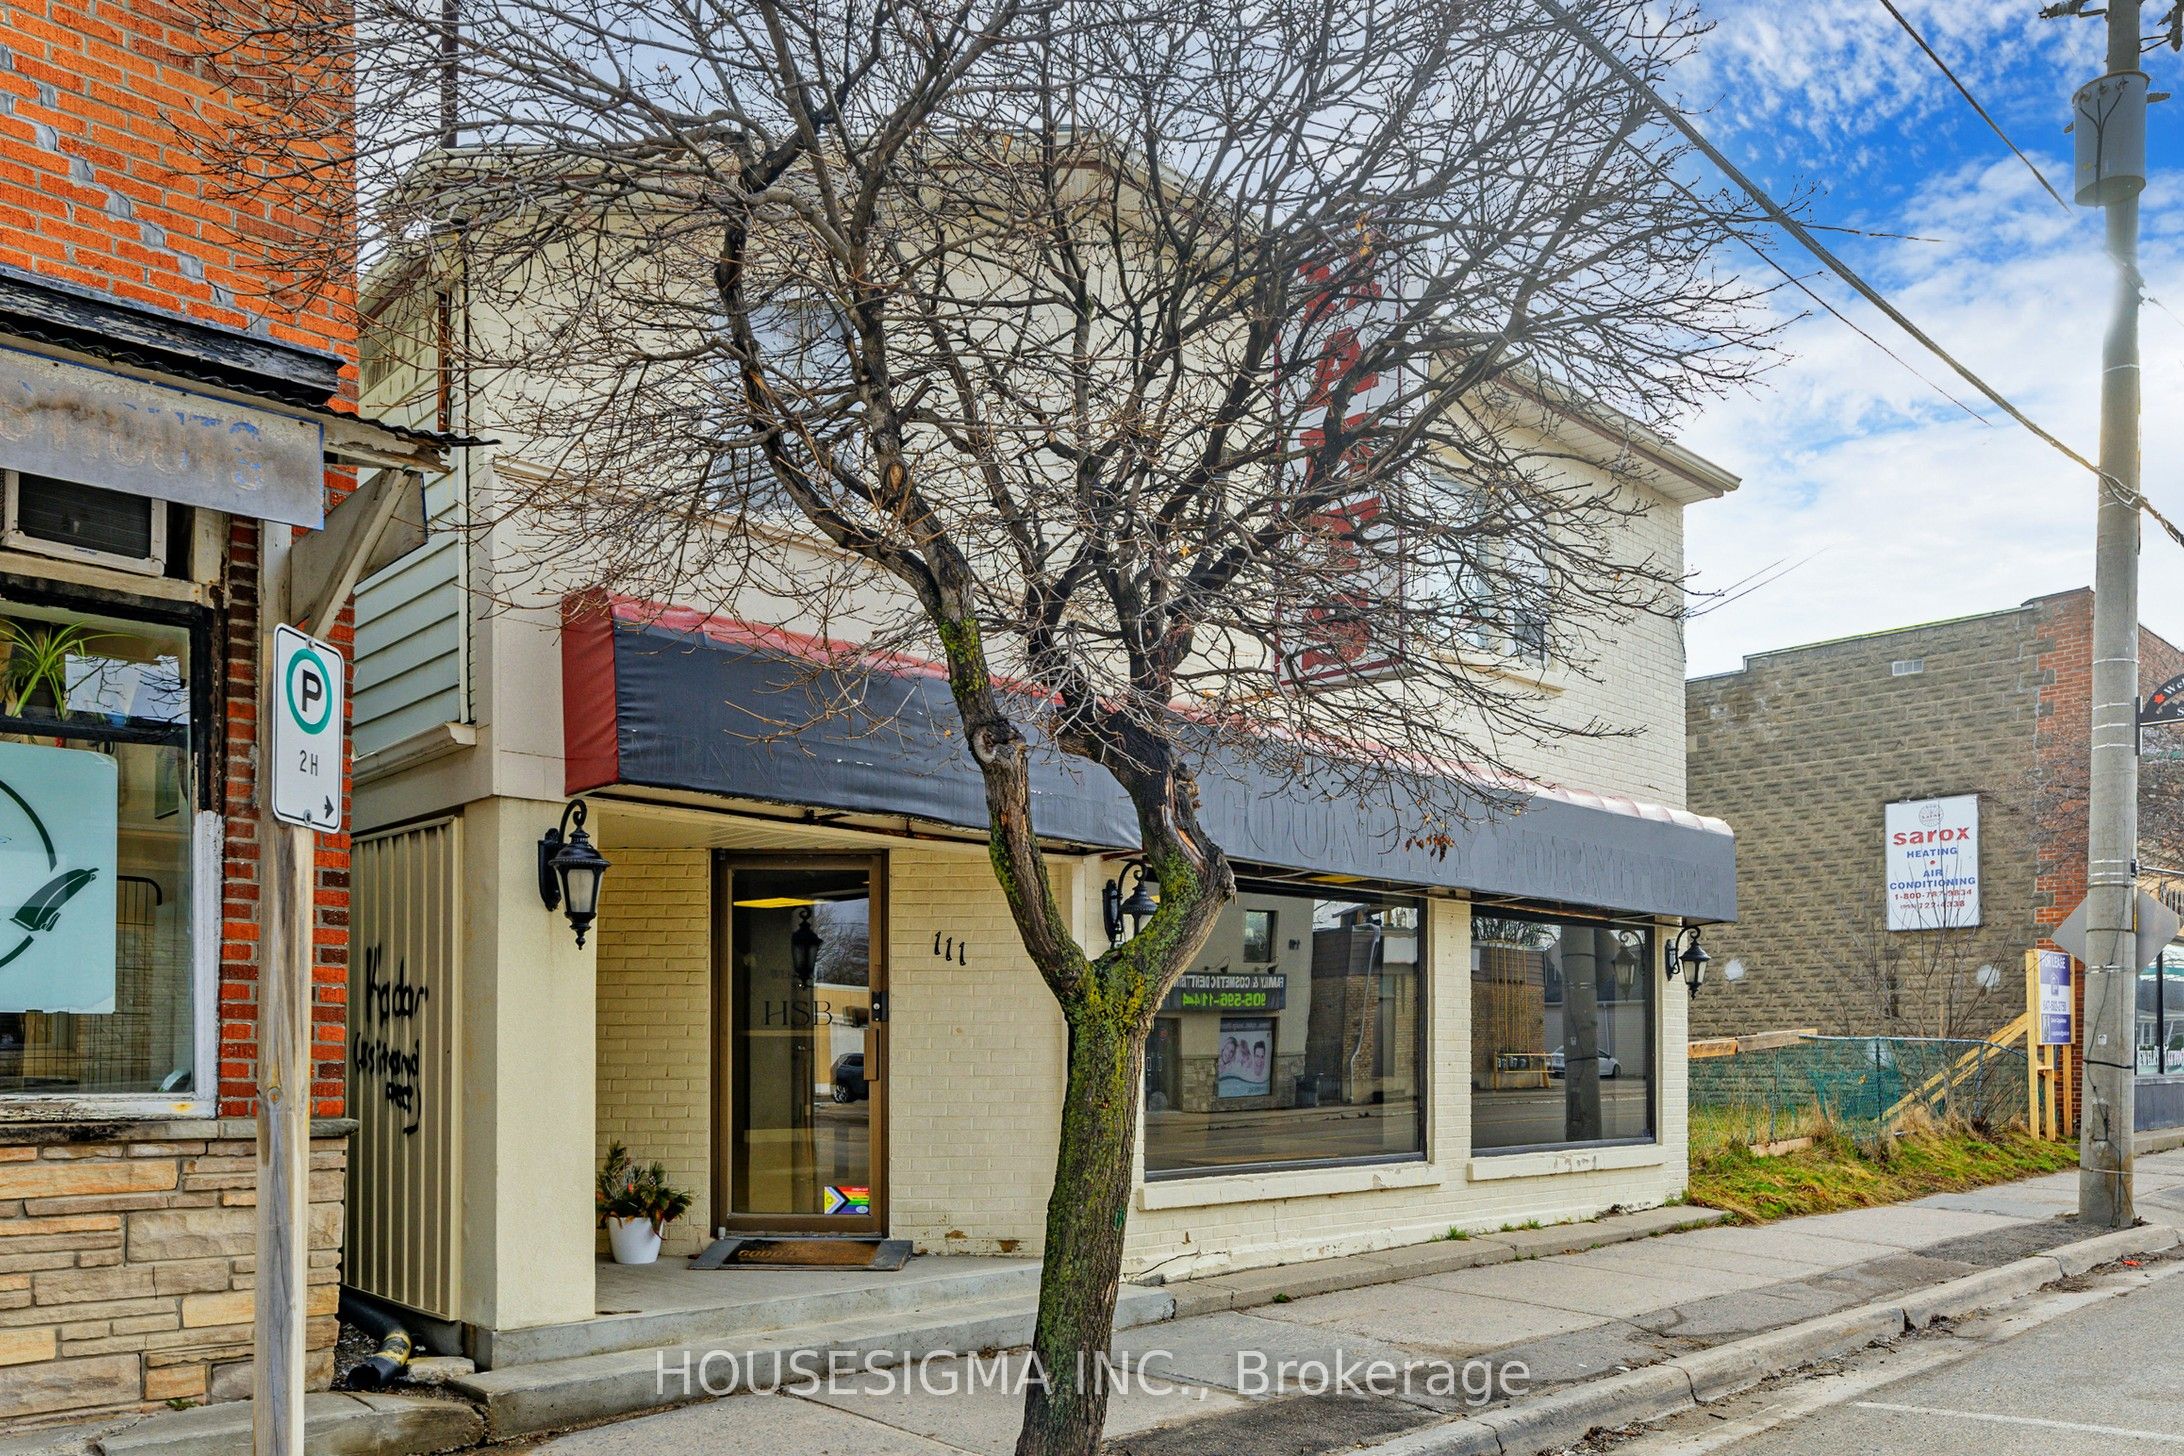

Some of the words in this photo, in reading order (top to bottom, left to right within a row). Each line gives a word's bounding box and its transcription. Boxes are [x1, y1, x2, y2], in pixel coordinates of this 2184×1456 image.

[302, 669, 322, 712] P
[299, 749, 318, 777] 2H
[1893, 826, 1970, 846] sarox
[1906, 847, 1958, 859] HEATING
[1889, 876, 1976, 891] CONDITIONING
[1923, 869, 1943, 878] AIR
[934, 931, 967, 967] 111
[763, 1000, 833, 1026] HSB
